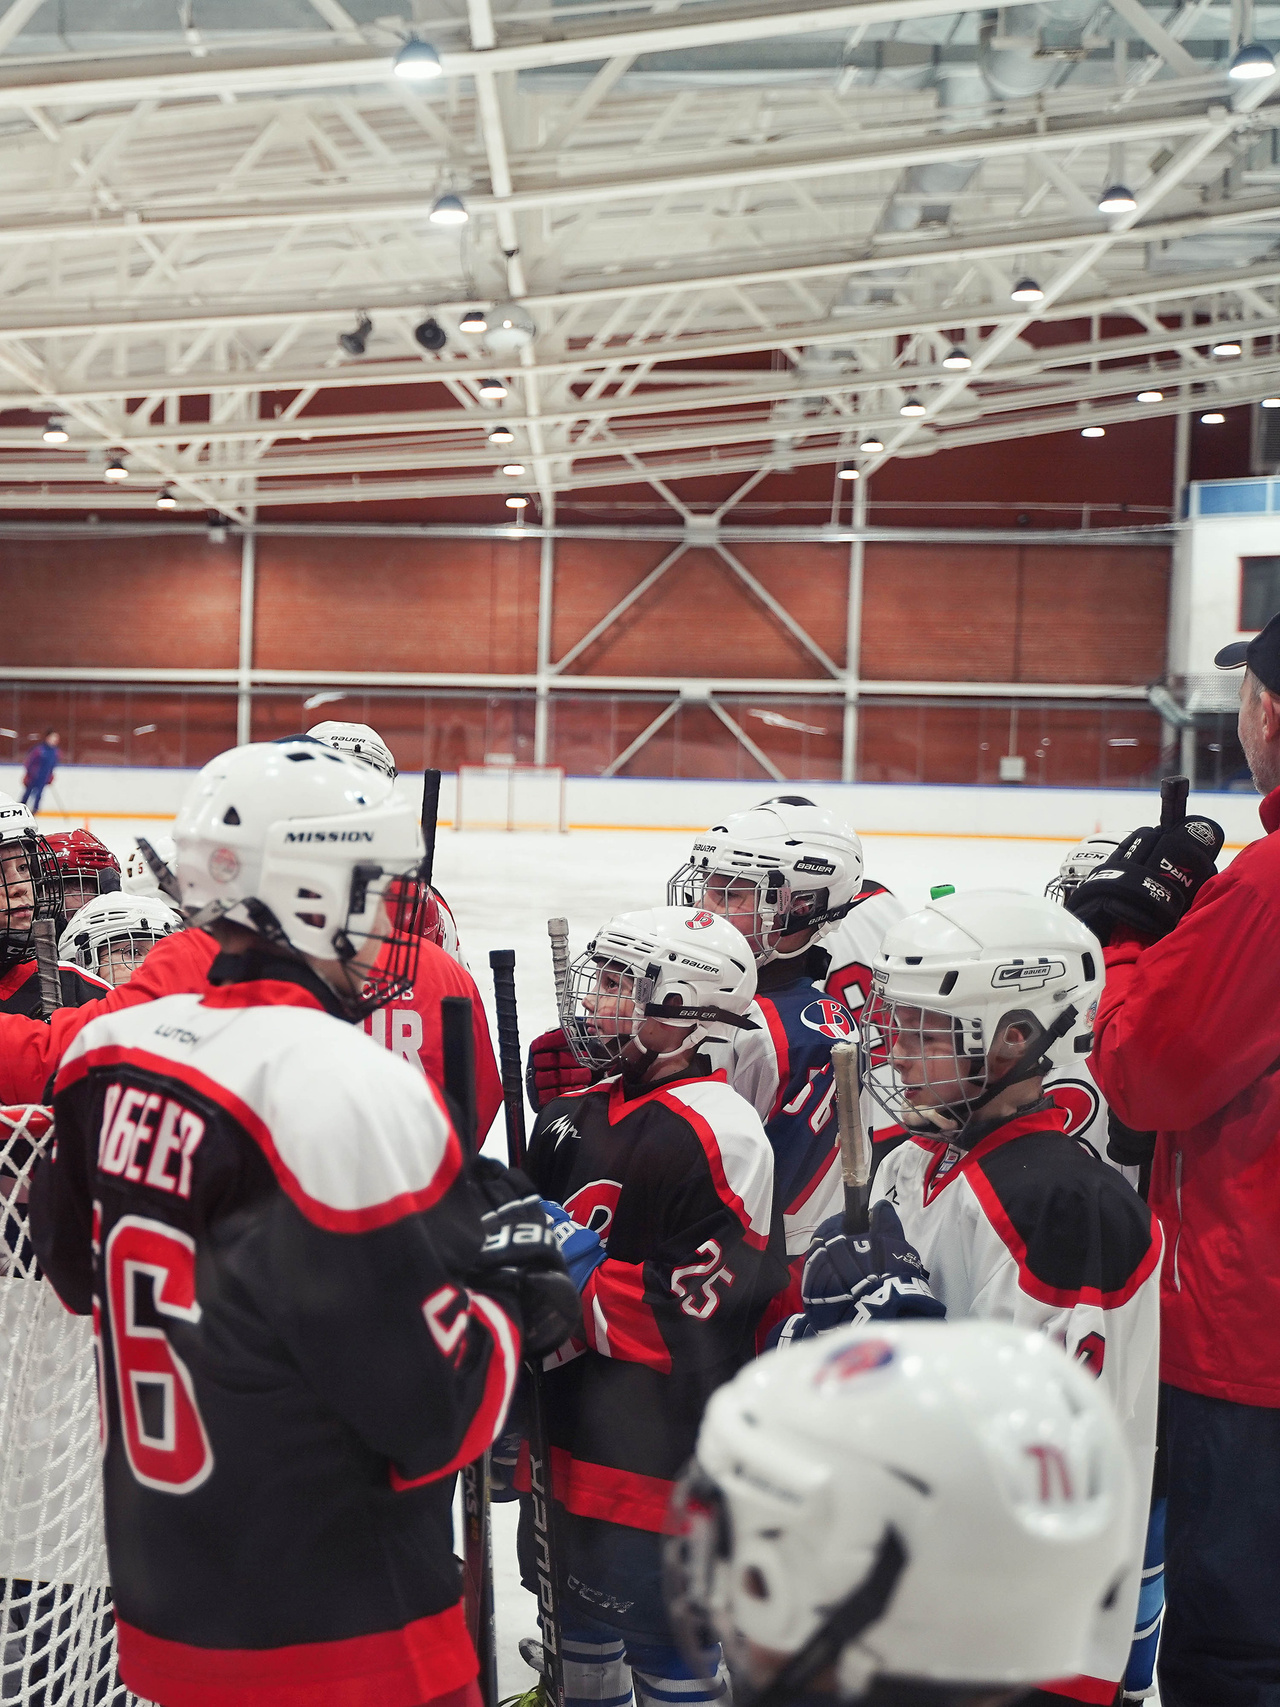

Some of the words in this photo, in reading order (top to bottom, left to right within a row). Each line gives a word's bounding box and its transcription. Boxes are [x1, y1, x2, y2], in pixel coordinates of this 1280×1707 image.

[331, 736, 366, 744] BAUER
[284, 830, 374, 844] MISSION
[1075, 852, 1105, 860] CCM
[796, 863, 833, 874] BAUER
[681, 958, 719, 974] BAUER
[1023, 967, 1047, 976] BAUER
[670, 1238, 736, 1321] 25
